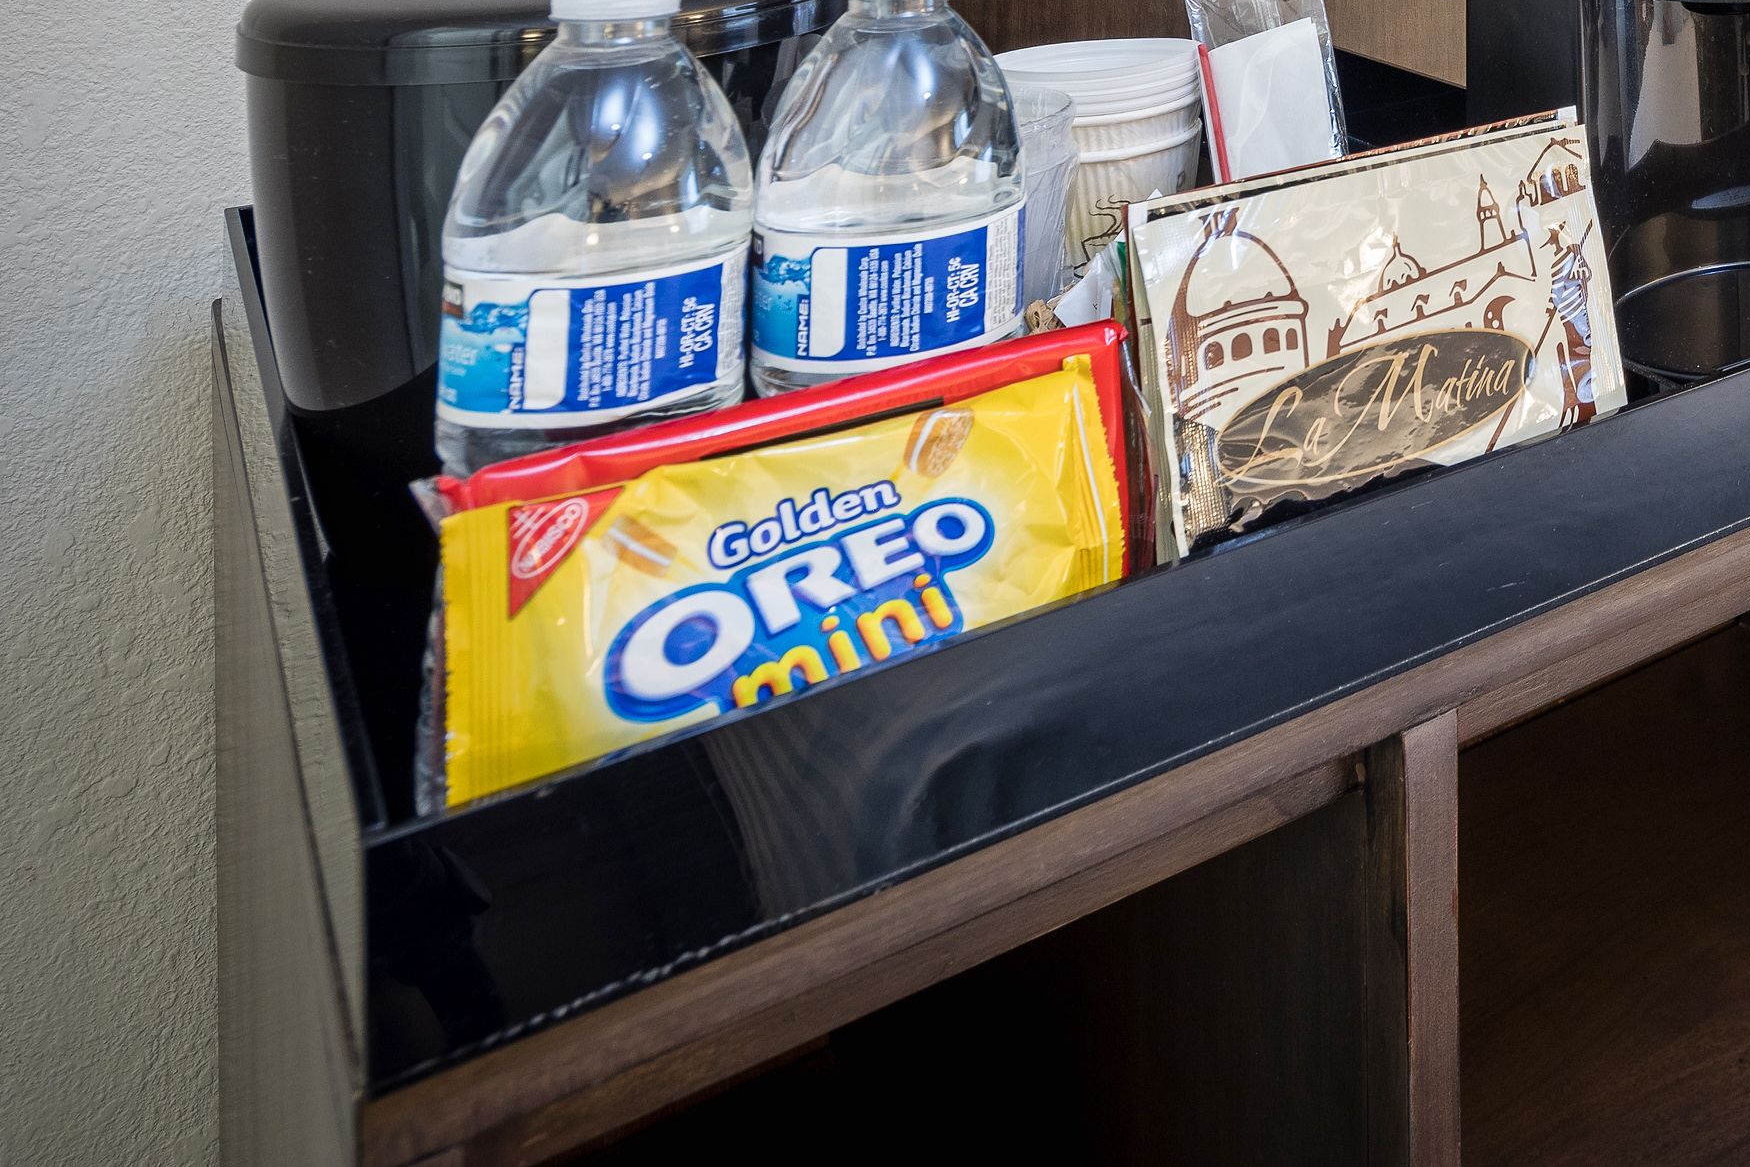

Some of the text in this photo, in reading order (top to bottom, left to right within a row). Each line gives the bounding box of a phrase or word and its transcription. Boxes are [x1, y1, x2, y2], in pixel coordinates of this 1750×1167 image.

[946, 271, 960, 323] HI-OR-CT:
[959, 263, 980, 308] CA CRV
[678, 312, 696, 369] HI-OR-CT:
[693, 303, 716, 353] CA CRV
[797, 298, 810, 356] NAME:
[508, 344, 525, 411] NAME:
[1216, 343, 1515, 487] La Matina
[707, 479, 901, 570] Golden
[618, 501, 988, 702] OREO
[731, 572, 954, 710] mini
